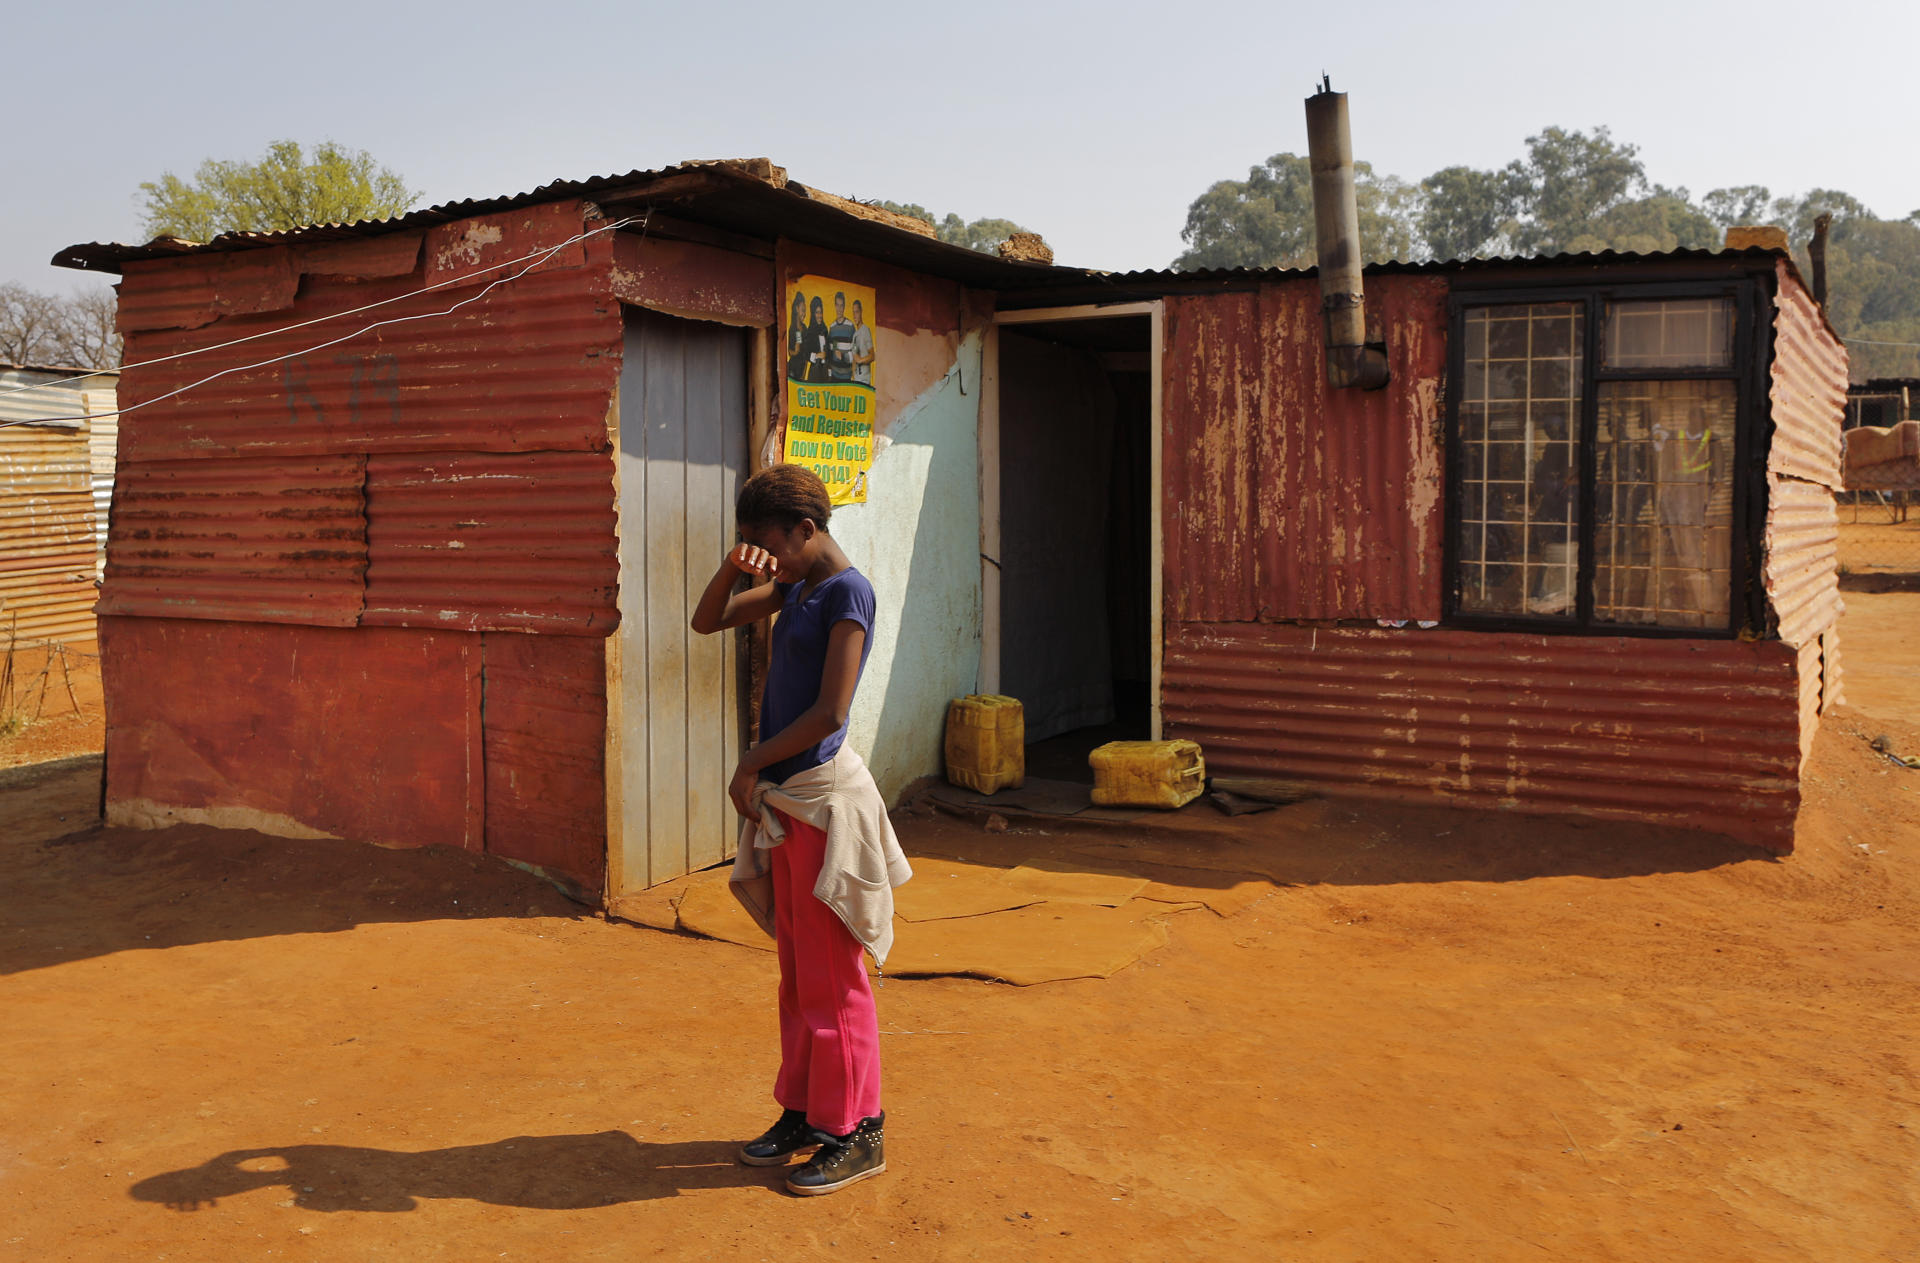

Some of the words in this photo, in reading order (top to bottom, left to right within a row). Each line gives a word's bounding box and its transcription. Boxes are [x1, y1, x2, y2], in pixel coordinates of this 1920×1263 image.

[797, 387, 820, 409] Get
[823, 390, 852, 412] Your
[853, 395, 867, 414] ID
[791, 413, 815, 433] and
[817, 415, 871, 438] Register
[790, 440, 818, 458] now
[821, 441, 834, 459] to
[836, 441, 867, 461] Vote
